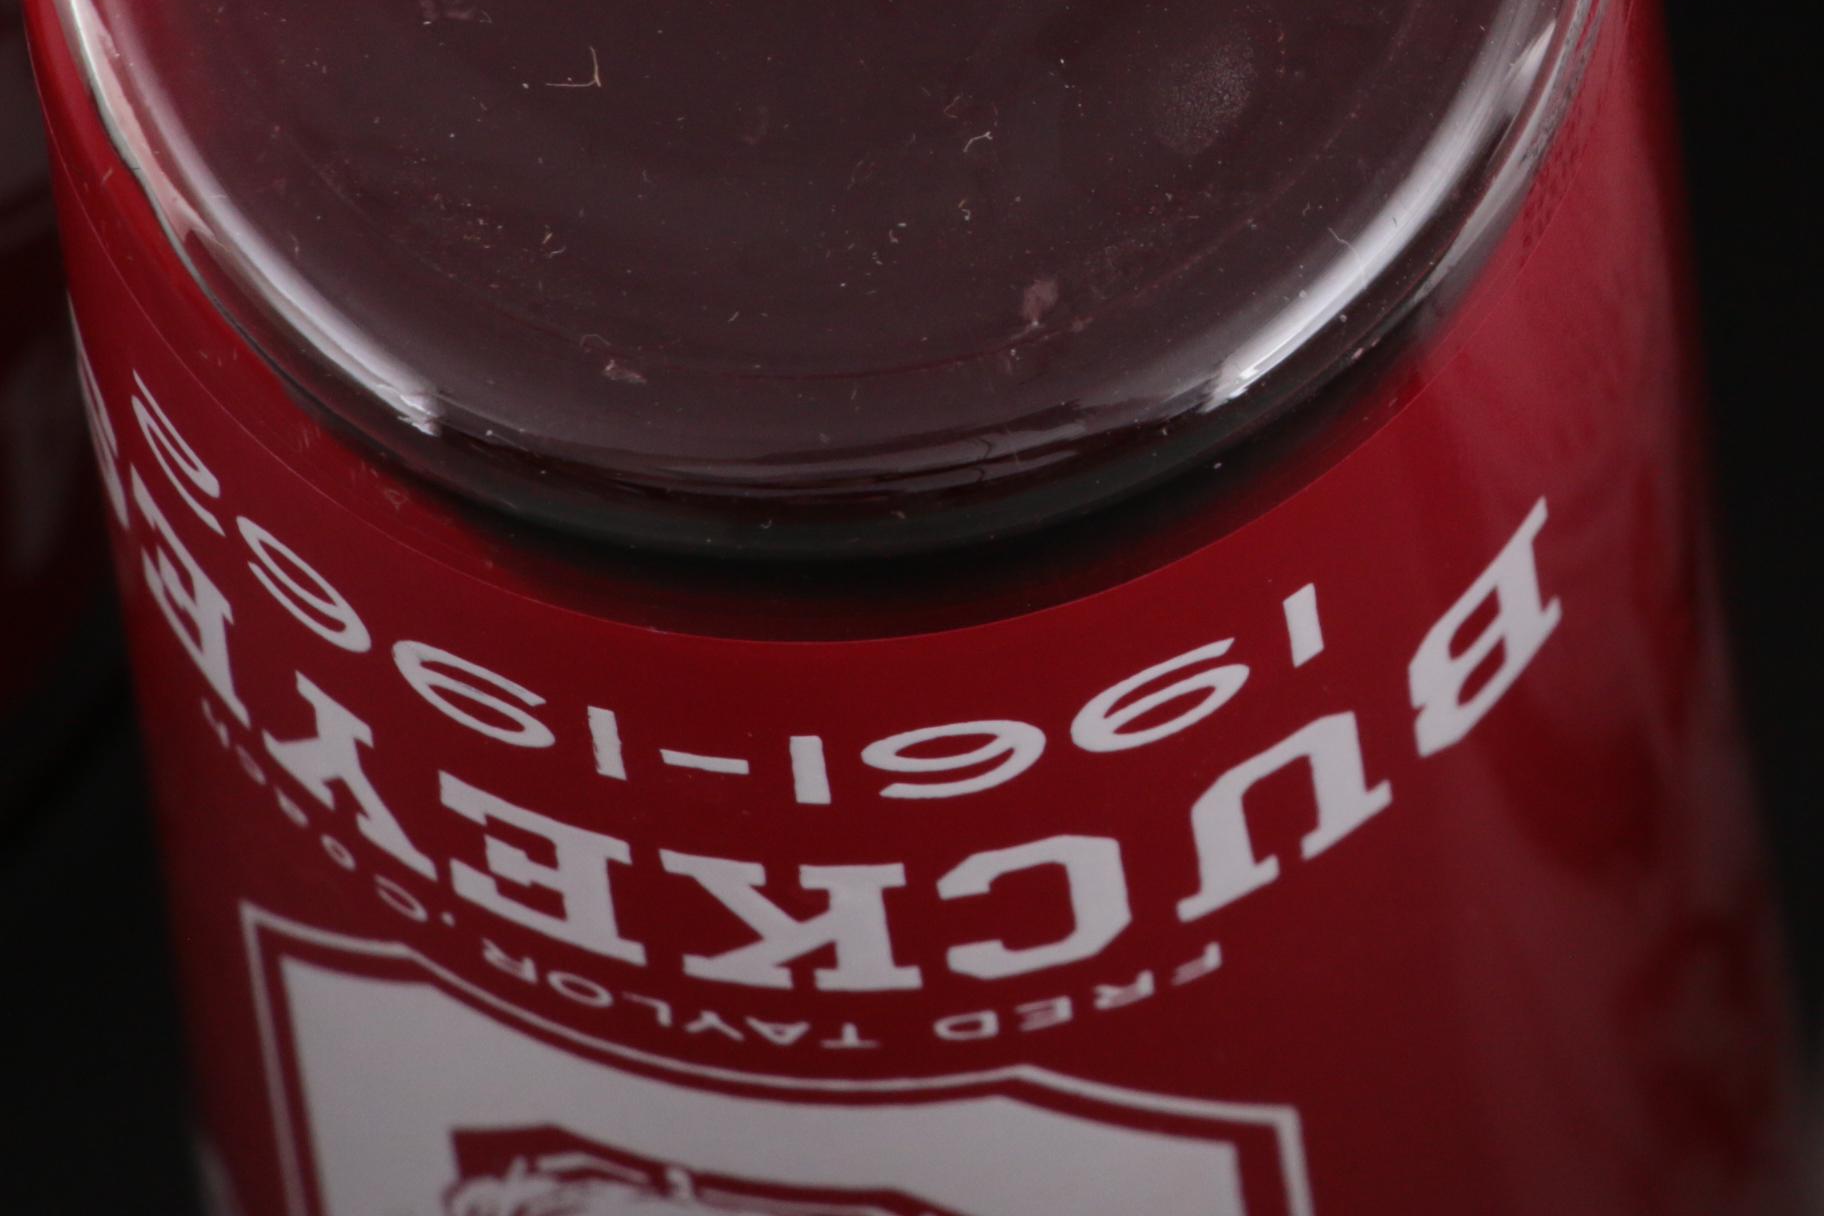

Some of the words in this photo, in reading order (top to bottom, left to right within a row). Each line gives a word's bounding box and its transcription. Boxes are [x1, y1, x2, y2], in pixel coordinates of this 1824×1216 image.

[66, 294, 1562, 990] BUCKEYES
[131, 369, 1324, 804] 1961-1962
[933, 941, 1223, 1041] FRED
